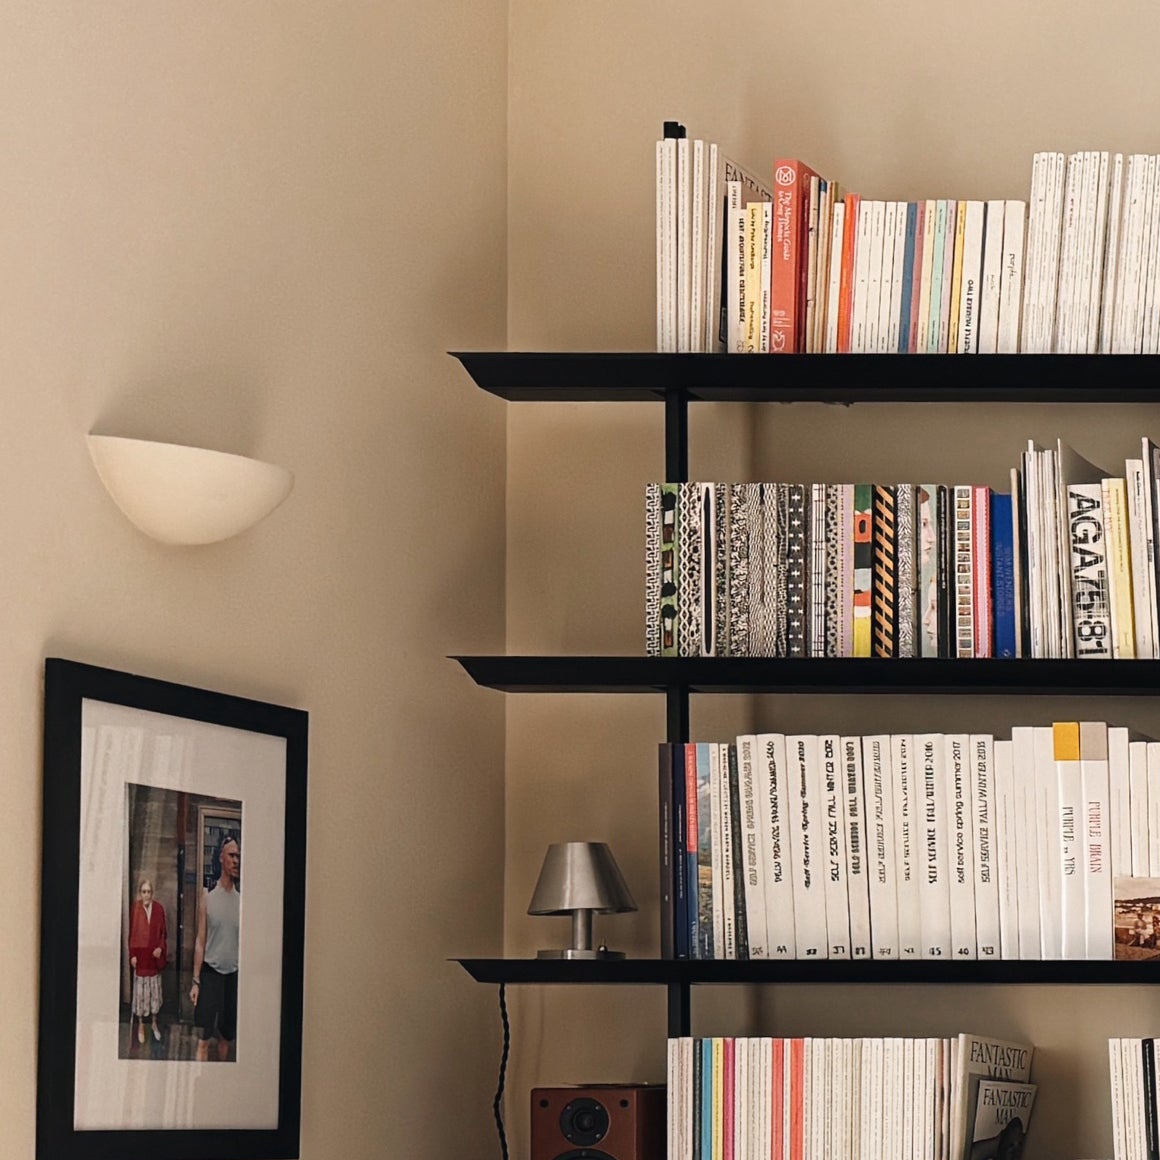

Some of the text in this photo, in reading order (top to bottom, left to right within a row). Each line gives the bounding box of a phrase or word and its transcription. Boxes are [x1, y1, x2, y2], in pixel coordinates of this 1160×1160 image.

[952, 741, 961, 760] 2017
[952, 761, 962, 799] summer
[828, 821, 838, 856] SERVICE
[926, 828, 936, 862] SERVICE
[955, 832, 965, 865] service
[979, 828, 989, 862] SERVICE
[1062, 806, 1076, 875] PURPLE YRS
[1089, 801, 1102, 873] PURPLE BRAIN
[970, 1041, 1028, 1070] FANTASTIC
[983, 1088, 1032, 1108] FANTASTIC
